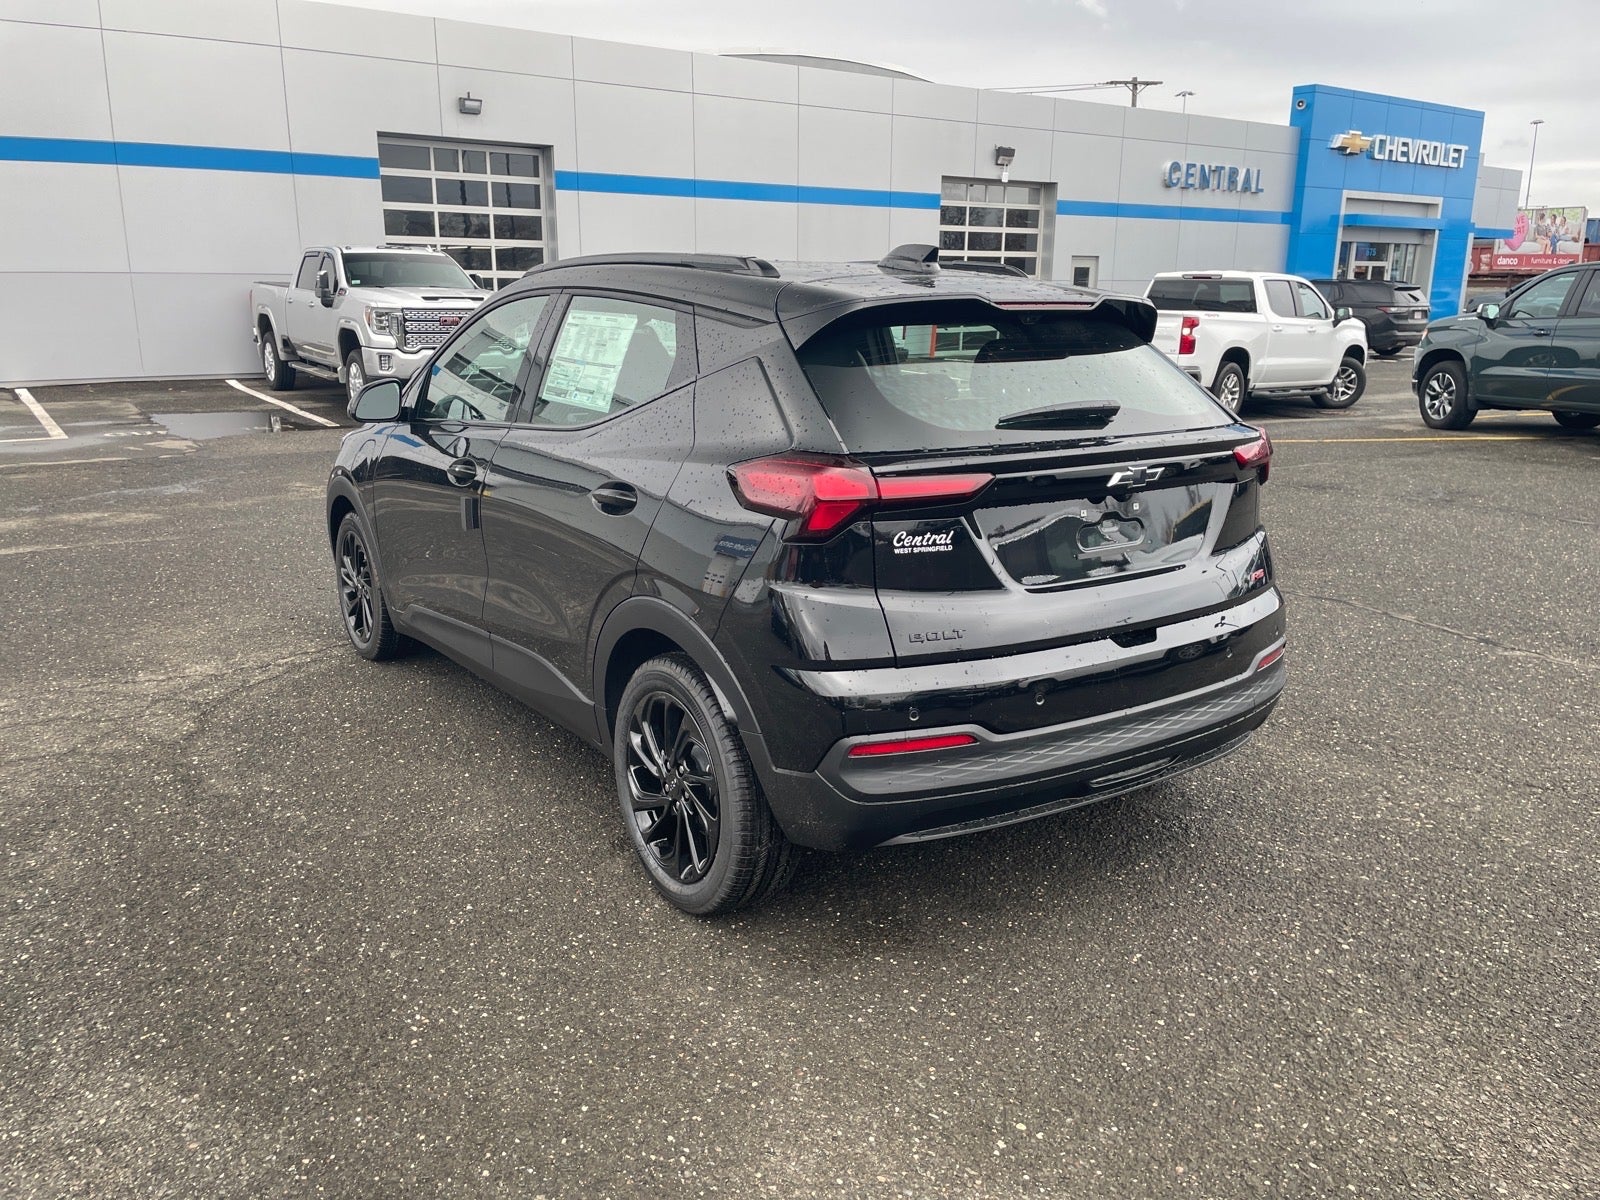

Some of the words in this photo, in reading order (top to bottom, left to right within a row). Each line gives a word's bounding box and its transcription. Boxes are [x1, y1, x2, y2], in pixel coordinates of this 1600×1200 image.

[1374, 134, 1469, 168] CHEVROLET
[1165, 161, 1264, 193] CENTRAL
[1497, 257, 1519, 265] danco
[893, 530, 955, 547] Central
[913, 544, 954, 554] SPRINGFIELD
